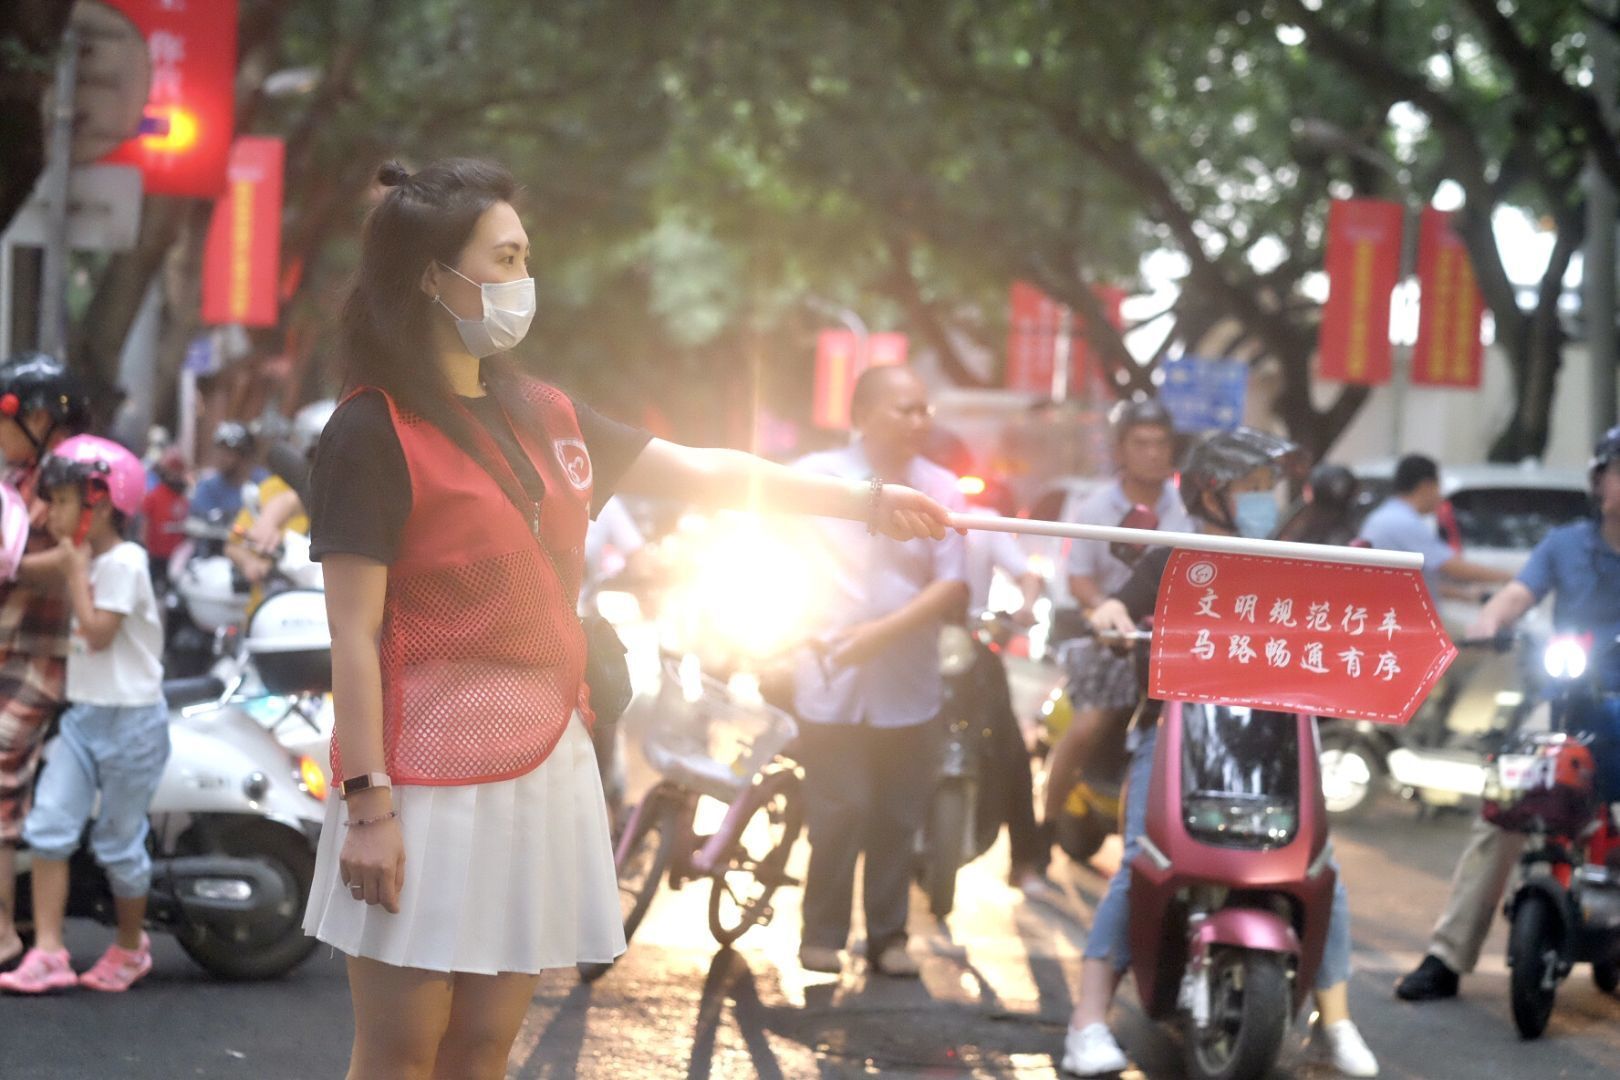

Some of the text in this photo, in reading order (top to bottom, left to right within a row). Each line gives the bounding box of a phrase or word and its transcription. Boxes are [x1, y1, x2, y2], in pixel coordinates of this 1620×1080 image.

[1195, 588, 1402, 641] 文明规范行车
[1190, 629, 1402, 682] 马路畅通有序
